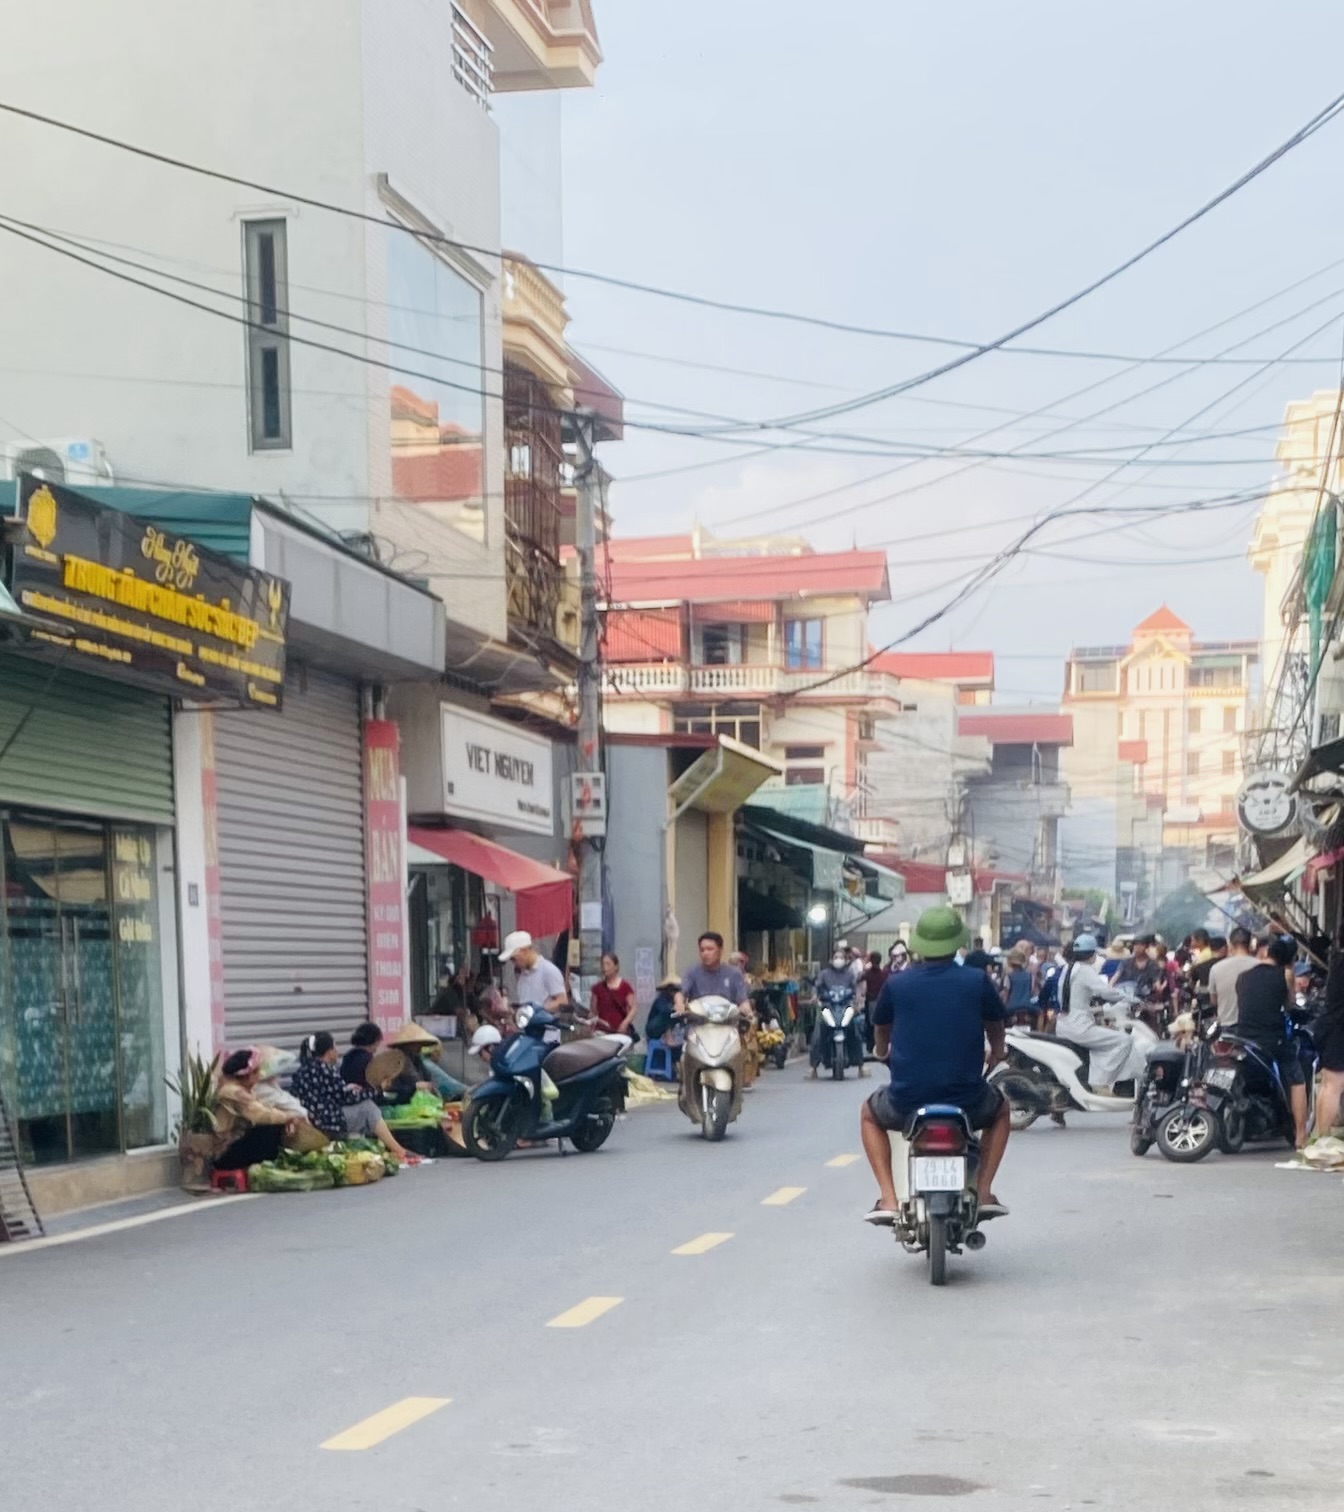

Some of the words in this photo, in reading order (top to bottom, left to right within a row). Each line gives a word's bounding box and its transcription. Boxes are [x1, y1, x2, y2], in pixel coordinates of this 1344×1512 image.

[368, 747, 397, 800] MUA
[372, 815, 399, 882] BÁN
[378, 989, 400, 1005] SIM
